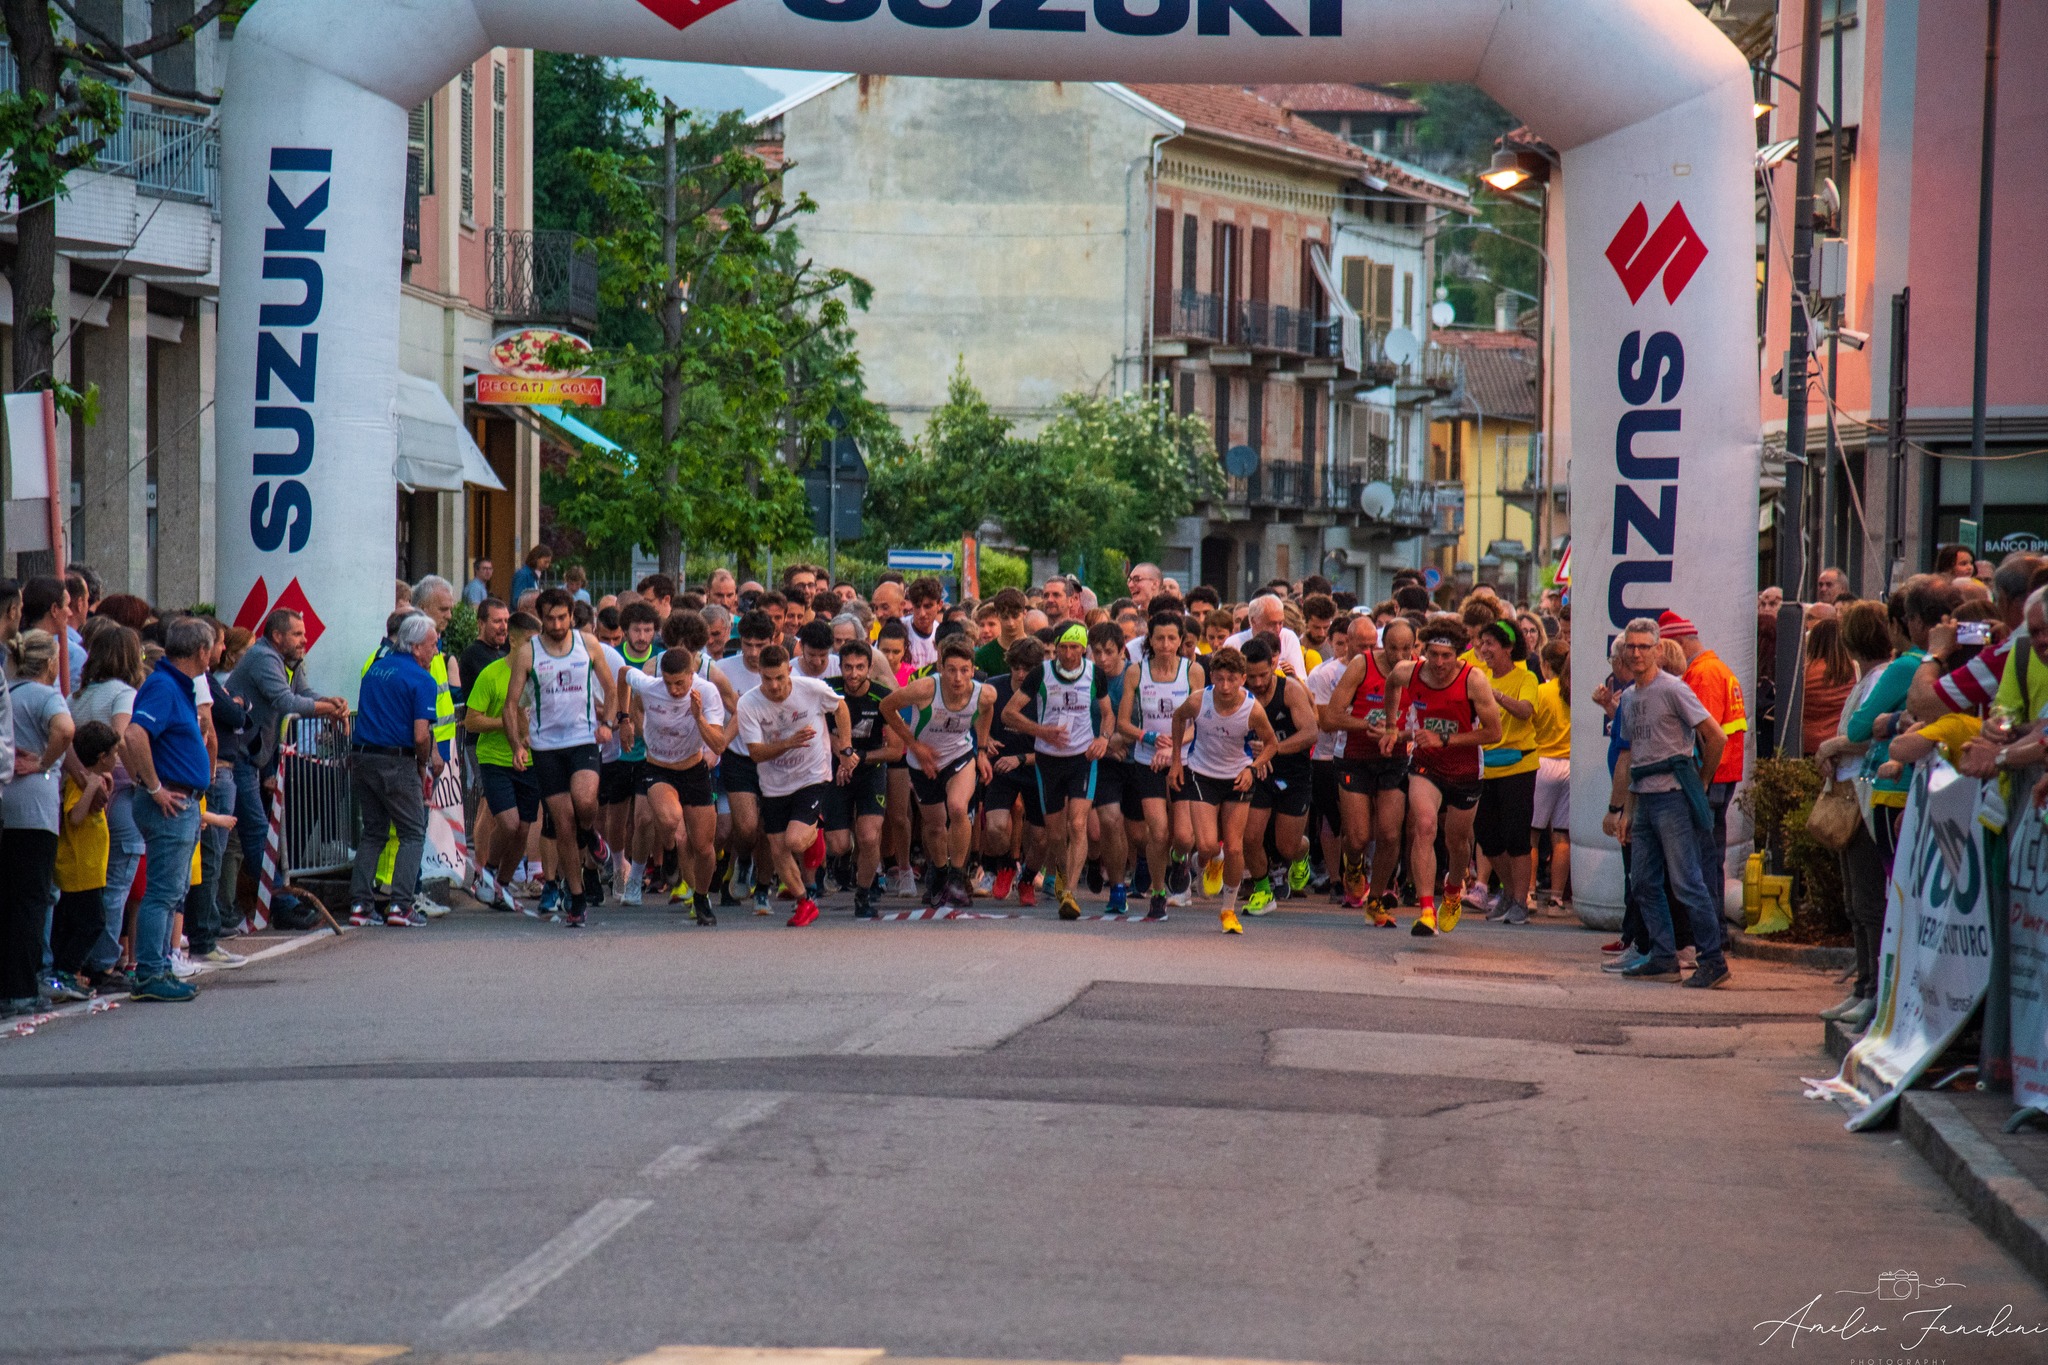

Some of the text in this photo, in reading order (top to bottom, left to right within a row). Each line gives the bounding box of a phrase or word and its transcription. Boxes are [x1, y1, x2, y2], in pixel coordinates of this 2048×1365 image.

[250, 147, 333, 553] SUZUKI
[481, 380, 545, 393] PECCATI
[560, 383, 600, 396] GOLA
[1602, 330, 1686, 737] SUZU
[1985, 541, 2029, 552] BANCO
